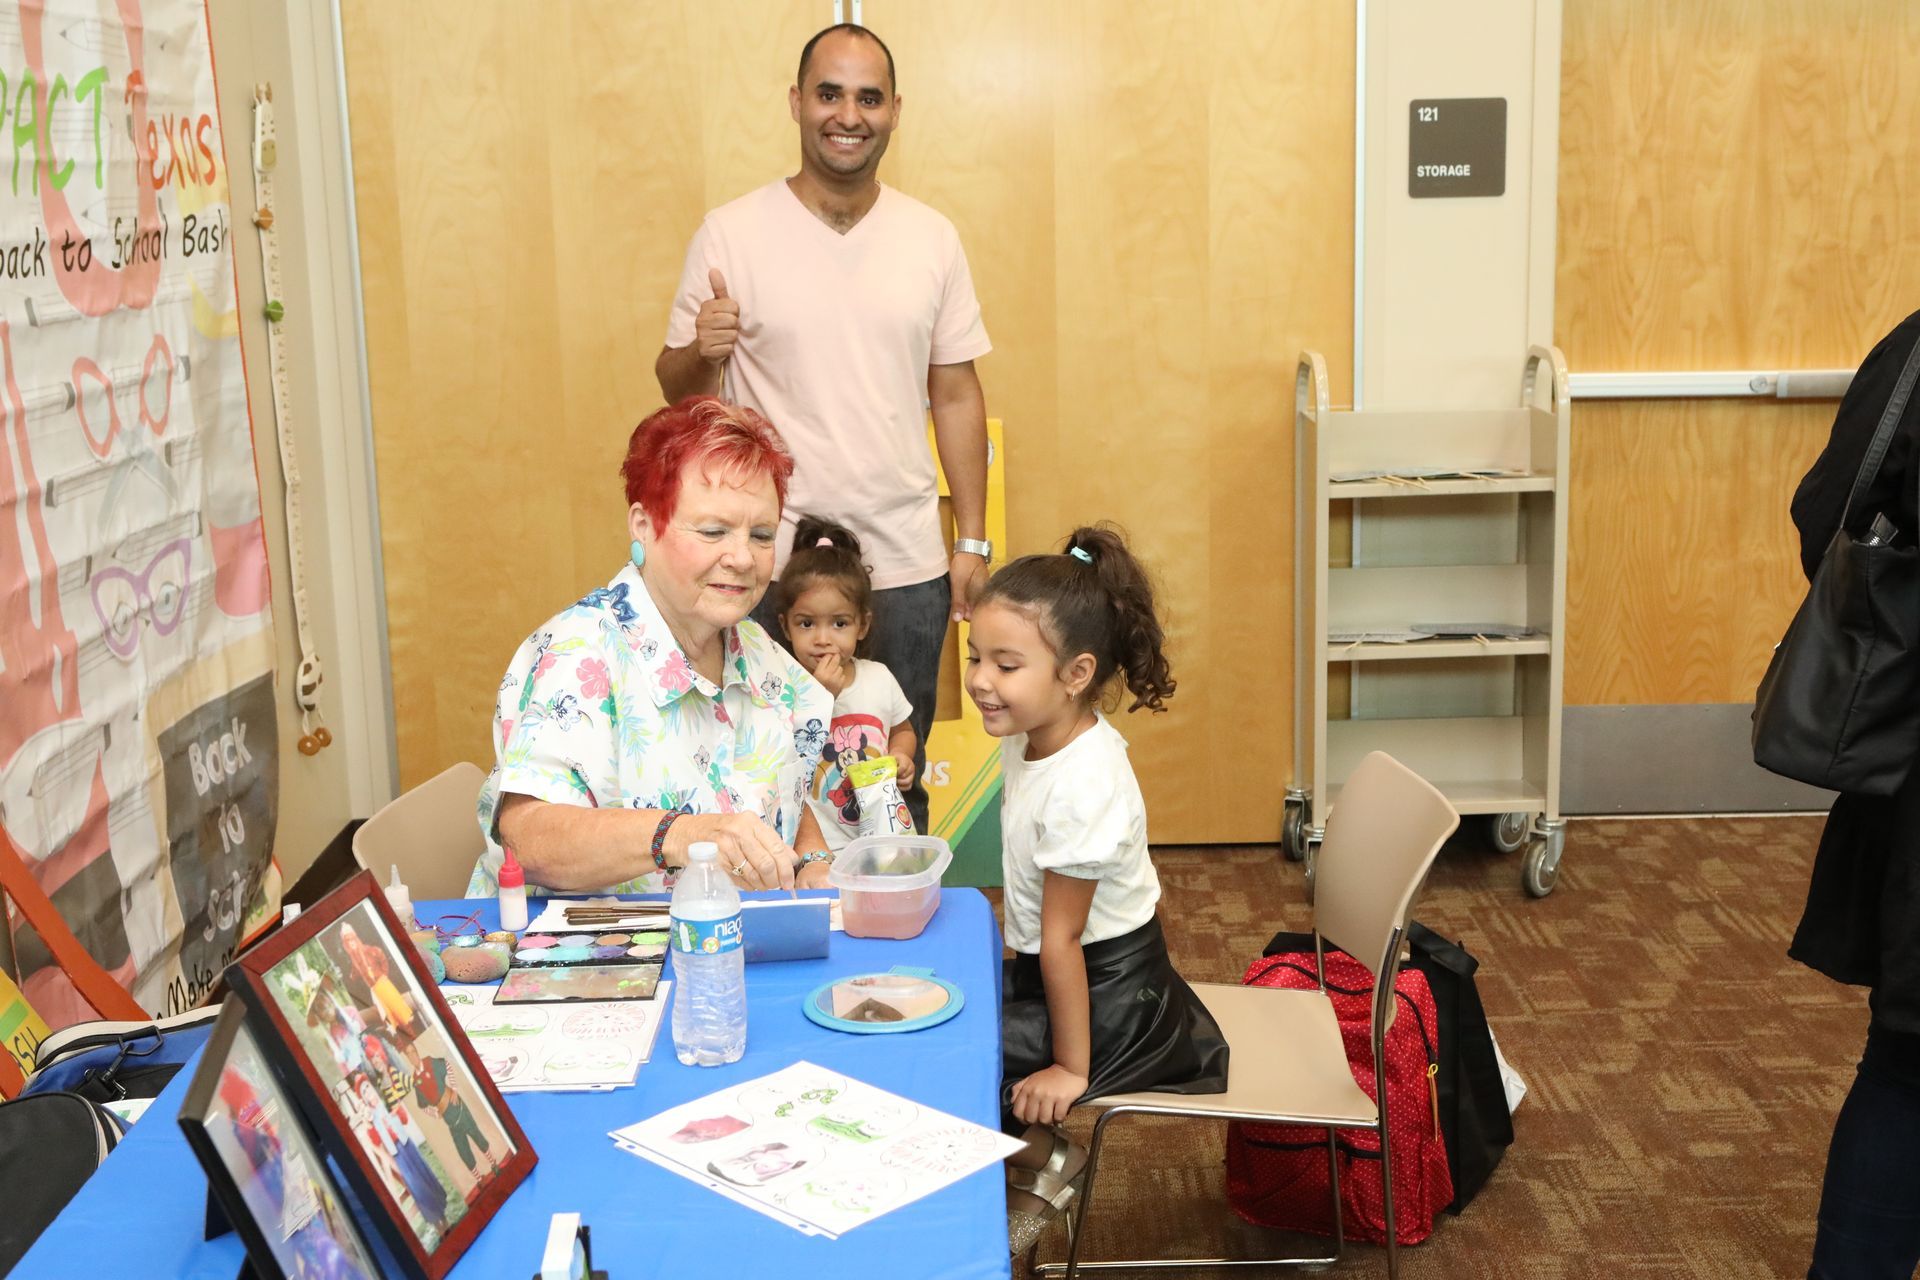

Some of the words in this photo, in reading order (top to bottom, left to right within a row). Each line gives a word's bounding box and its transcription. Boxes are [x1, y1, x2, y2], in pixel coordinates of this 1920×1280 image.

[124, 69, 216, 190] Texas
[1417, 106, 1439, 122] 121
[1416, 164, 1471, 178] STORAGE
[61, 229, 92, 272] to
[111, 213, 168, 268] School
